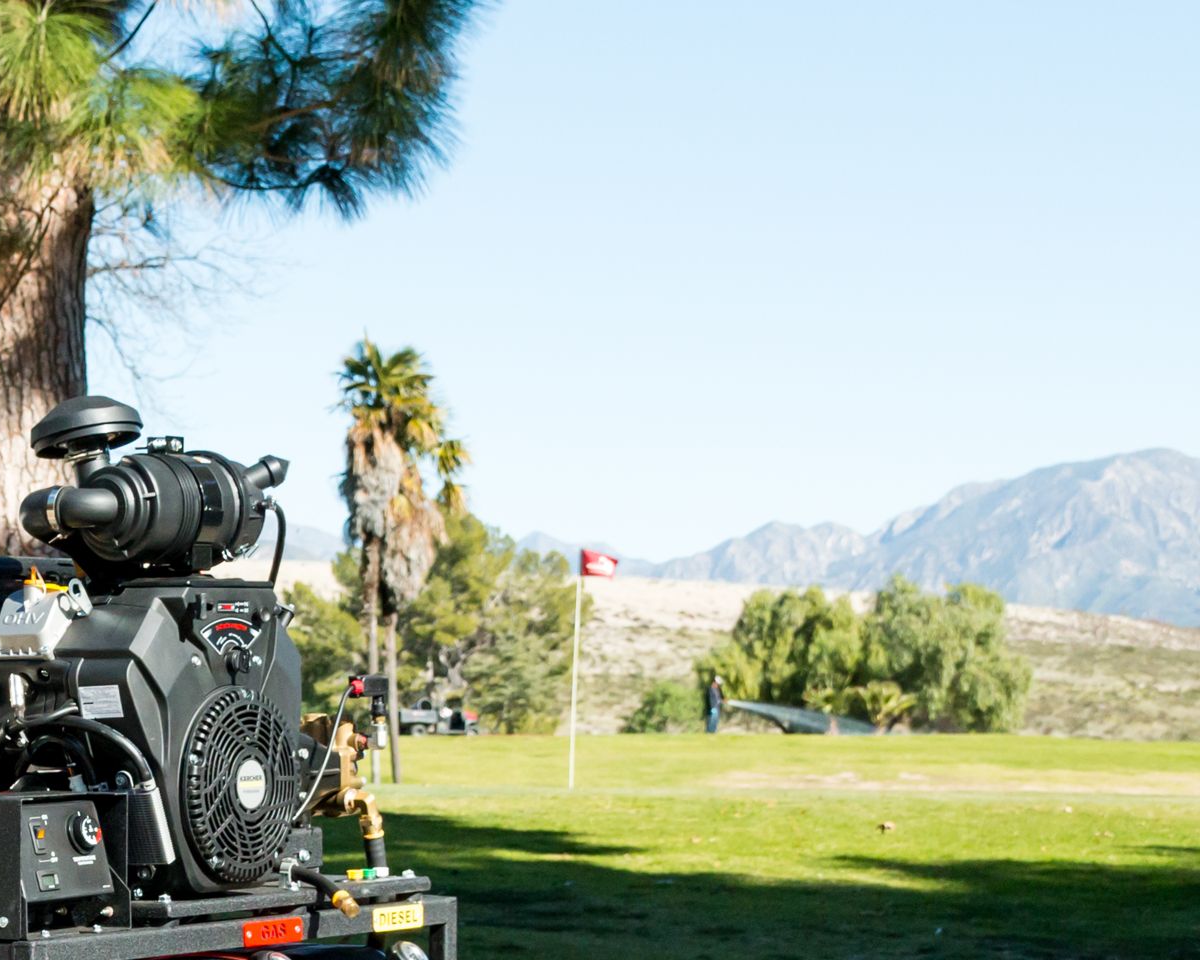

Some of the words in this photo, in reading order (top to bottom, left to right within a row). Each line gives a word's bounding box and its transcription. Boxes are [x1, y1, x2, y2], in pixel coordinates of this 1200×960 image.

[3, 611, 45, 625] OHV
[379, 910, 418, 926] DIESEL
[261, 923, 287, 939] GAS
